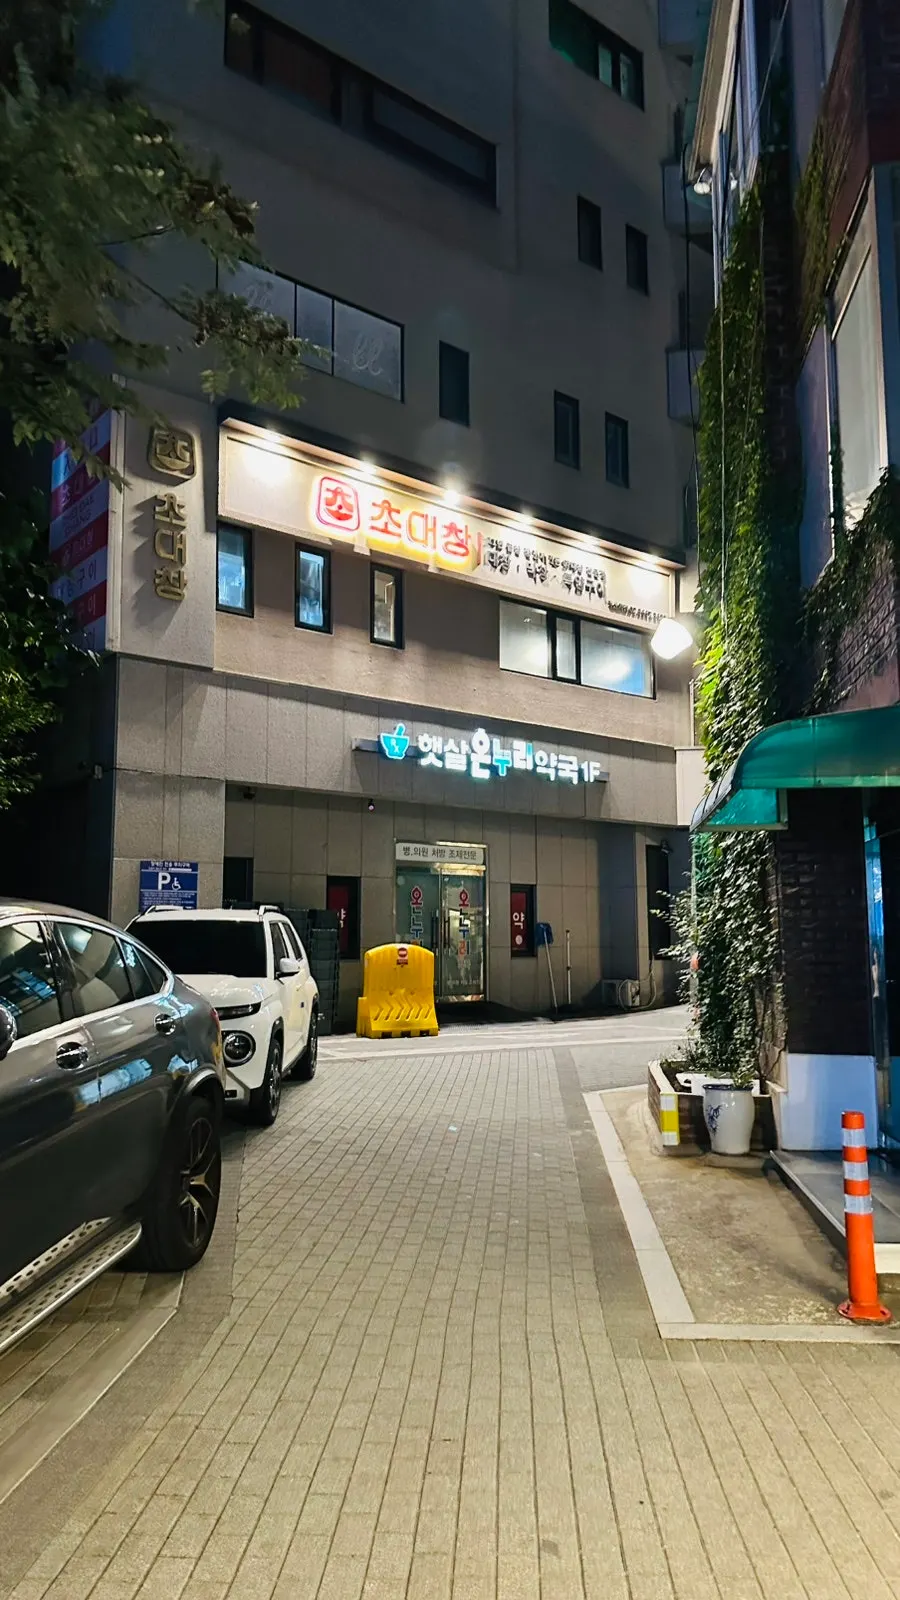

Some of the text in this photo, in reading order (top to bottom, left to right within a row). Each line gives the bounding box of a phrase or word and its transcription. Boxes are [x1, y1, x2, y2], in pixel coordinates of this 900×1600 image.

[154, 492, 188, 601] 초대창
[369, 499, 473, 558] 초대창
[157, 872, 171, 890] P
[512, 911, 525, 930] 약
